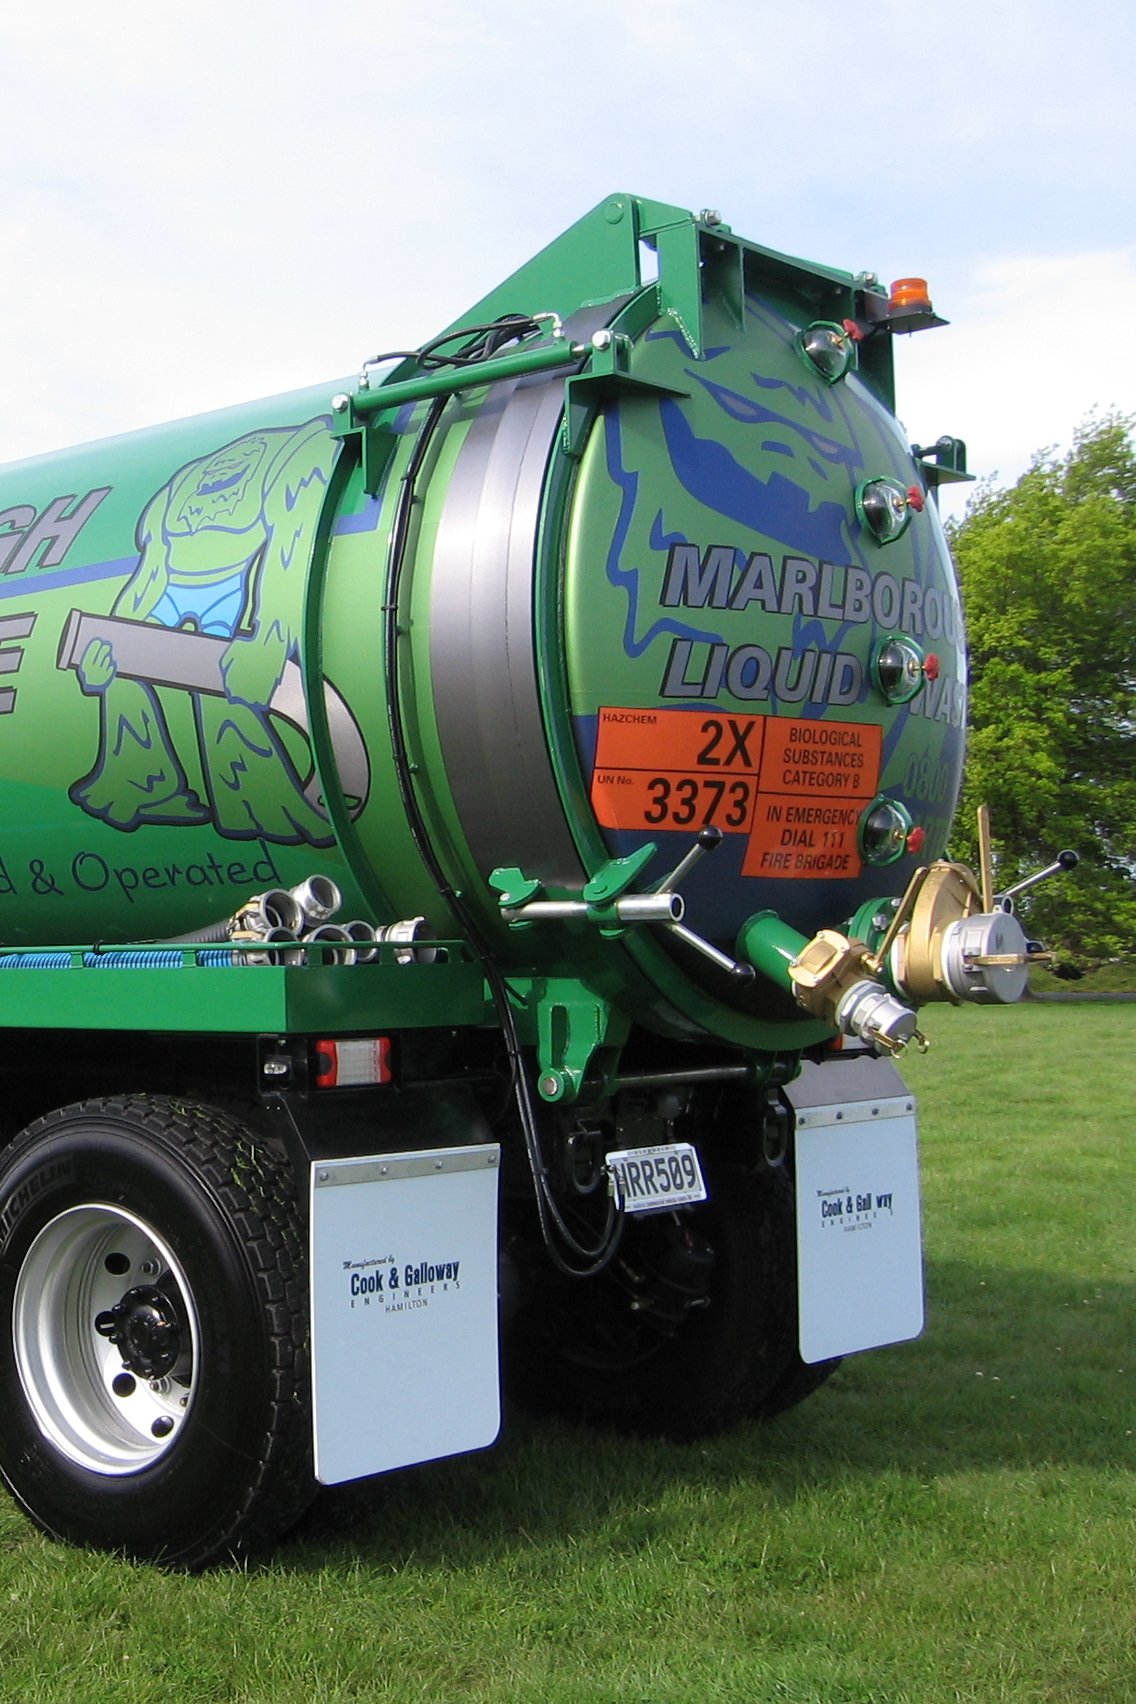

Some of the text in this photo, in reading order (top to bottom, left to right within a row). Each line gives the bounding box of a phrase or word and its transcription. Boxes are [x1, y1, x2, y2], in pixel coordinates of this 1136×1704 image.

[659, 638, 863, 706] LIQUID
[602, 713, 657, 725] HAZCHEM
[696, 719, 756, 768] 2X
[789, 727, 862, 747] BIOLOGICAL
[783, 748, 864, 769] SUBSTANCES
[597, 775, 634, 785] UN No.
[783, 769, 860, 789] CATEGORY B
[644, 777, 750, 827] 3373
[766, 805, 864, 826] IN EMERGENCY
[781, 829, 845, 848] DIAL 111
[28, 858, 66, 897] &
[70, 837, 283, 904] Operated
[760, 851, 850, 870] FIRE BRIGADE
[350, 1261, 460, 1296] Cook & Galloway
[350, 1281, 461, 1309] ENGINEERS
[385, 1299, 428, 1313] HAMILTON
